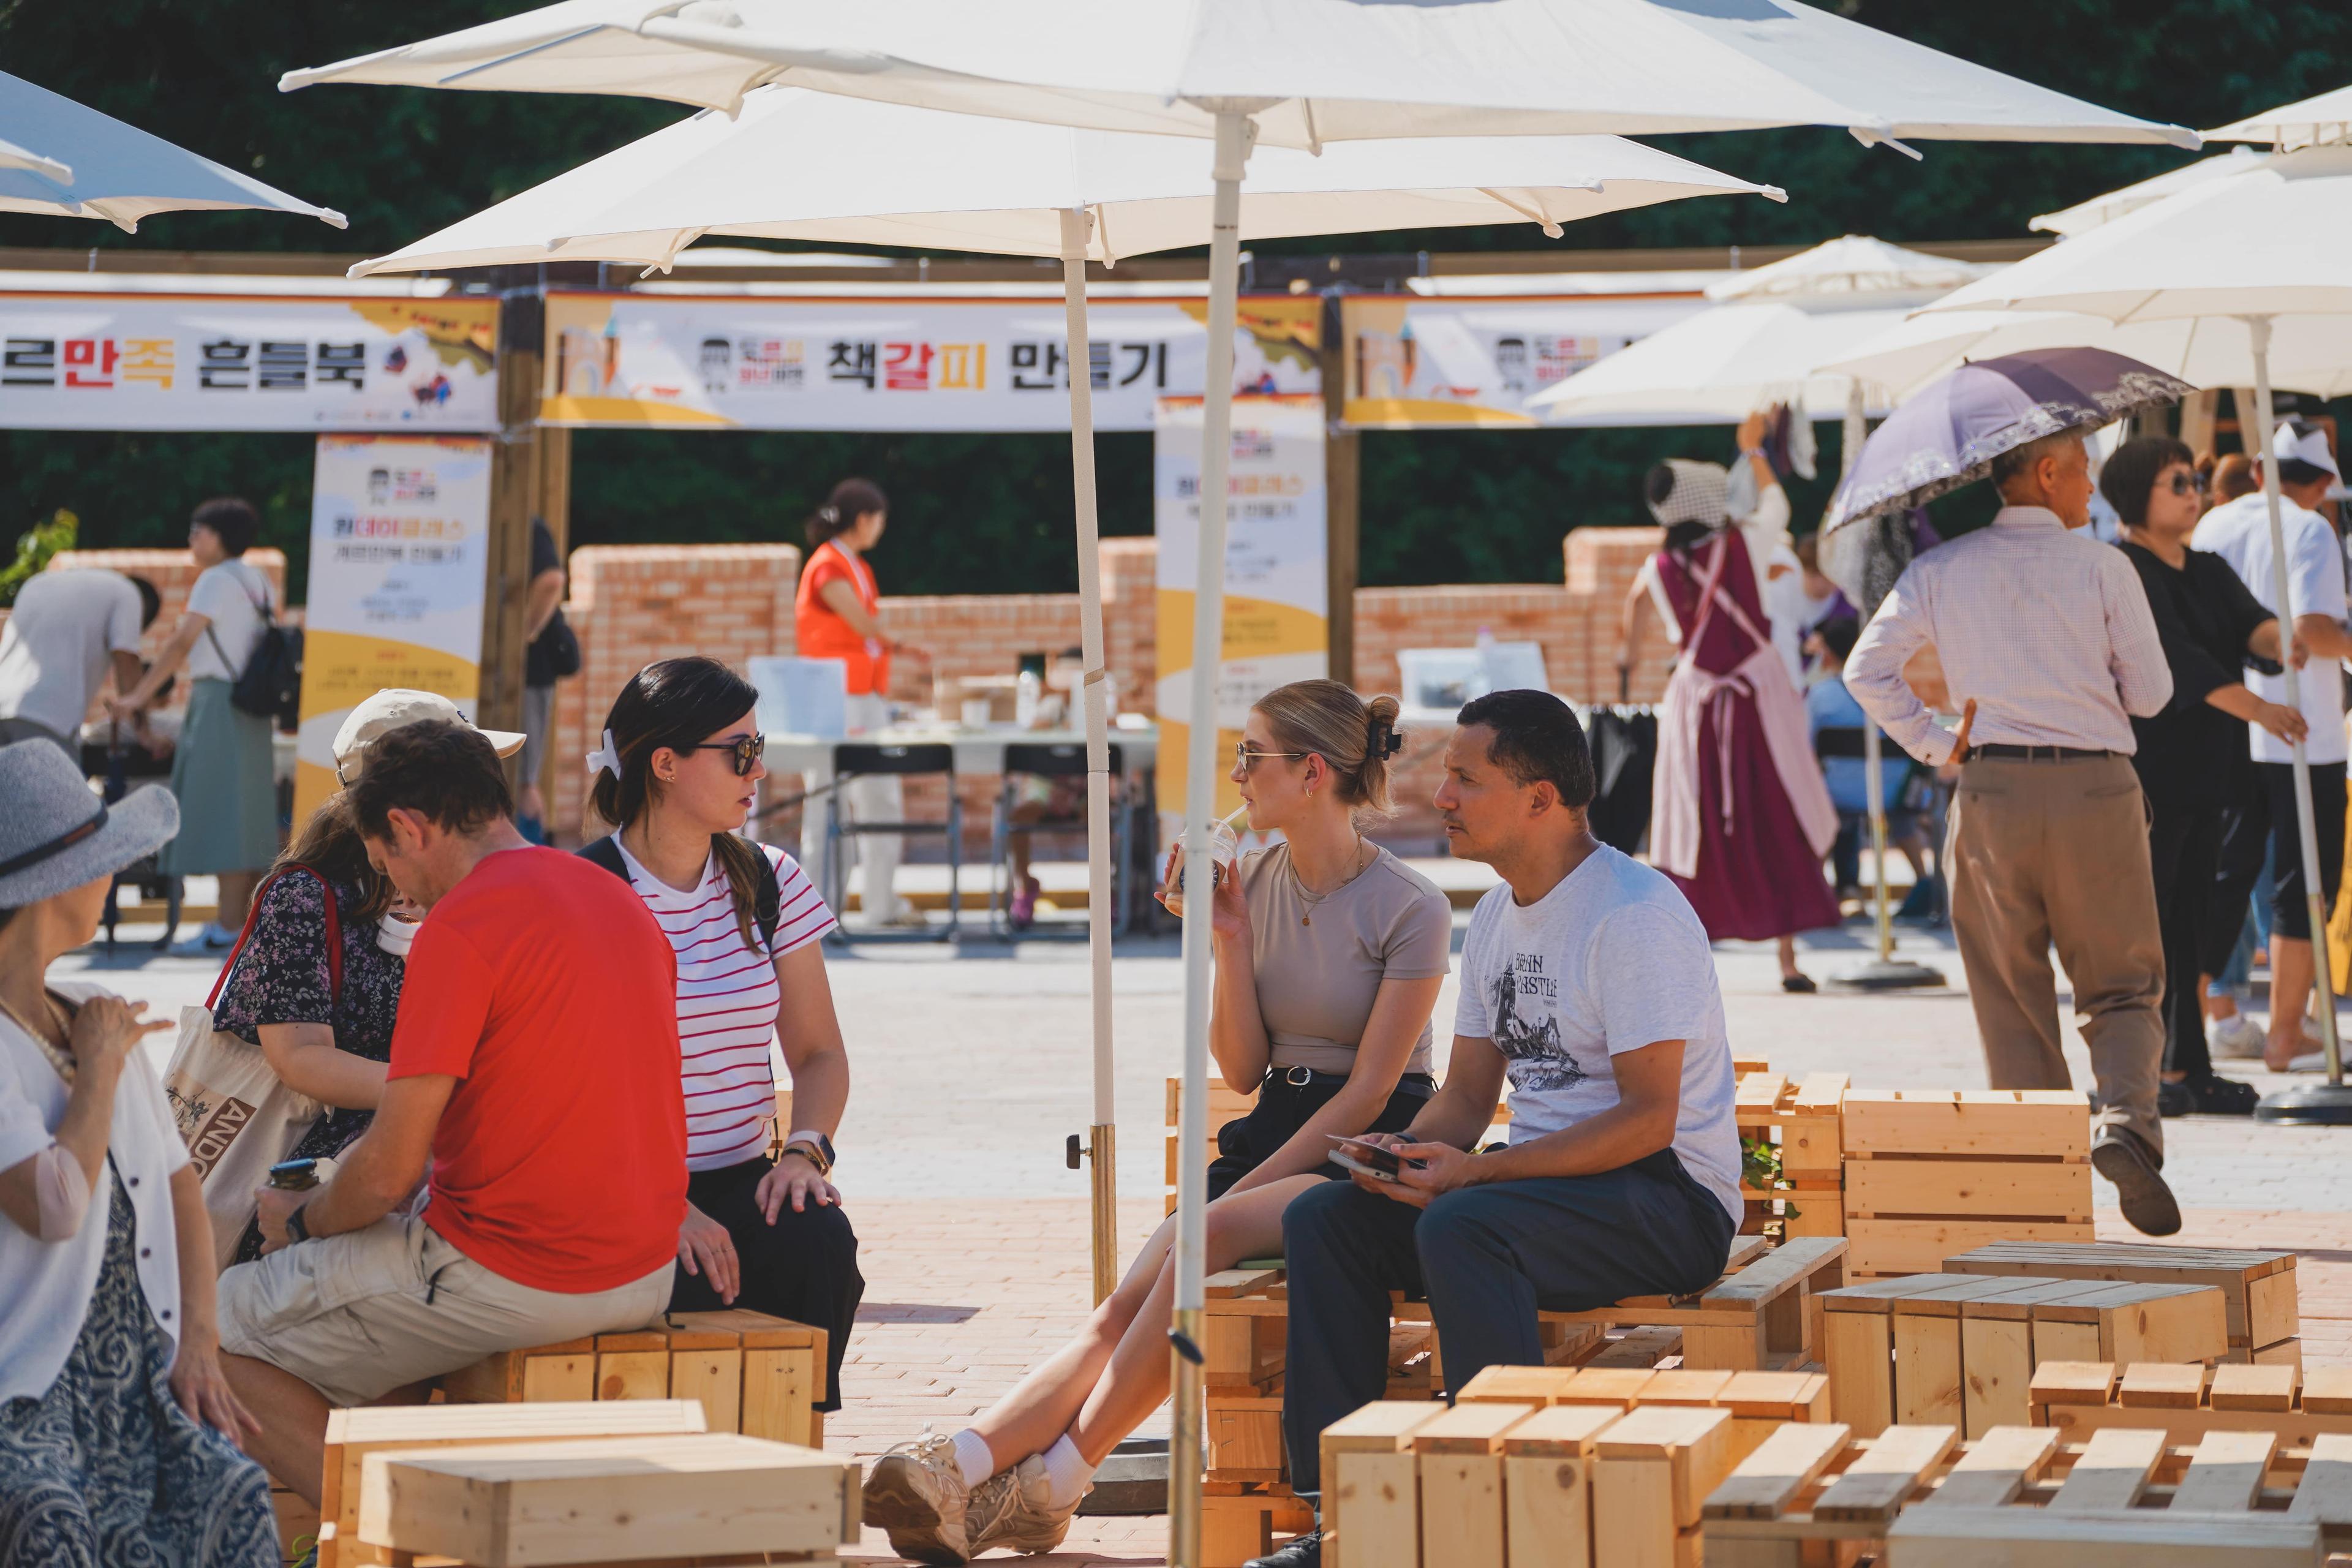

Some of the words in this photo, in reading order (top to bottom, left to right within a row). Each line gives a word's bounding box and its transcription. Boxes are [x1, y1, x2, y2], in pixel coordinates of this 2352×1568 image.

[2, 339, 175, 390] 르만족
[200, 341, 365, 389] 흔들북
[828, 341, 987, 390] 책갈피
[1515, 953, 1544, 973] BRAN
[1517, 975, 1557, 998] CASTLE
